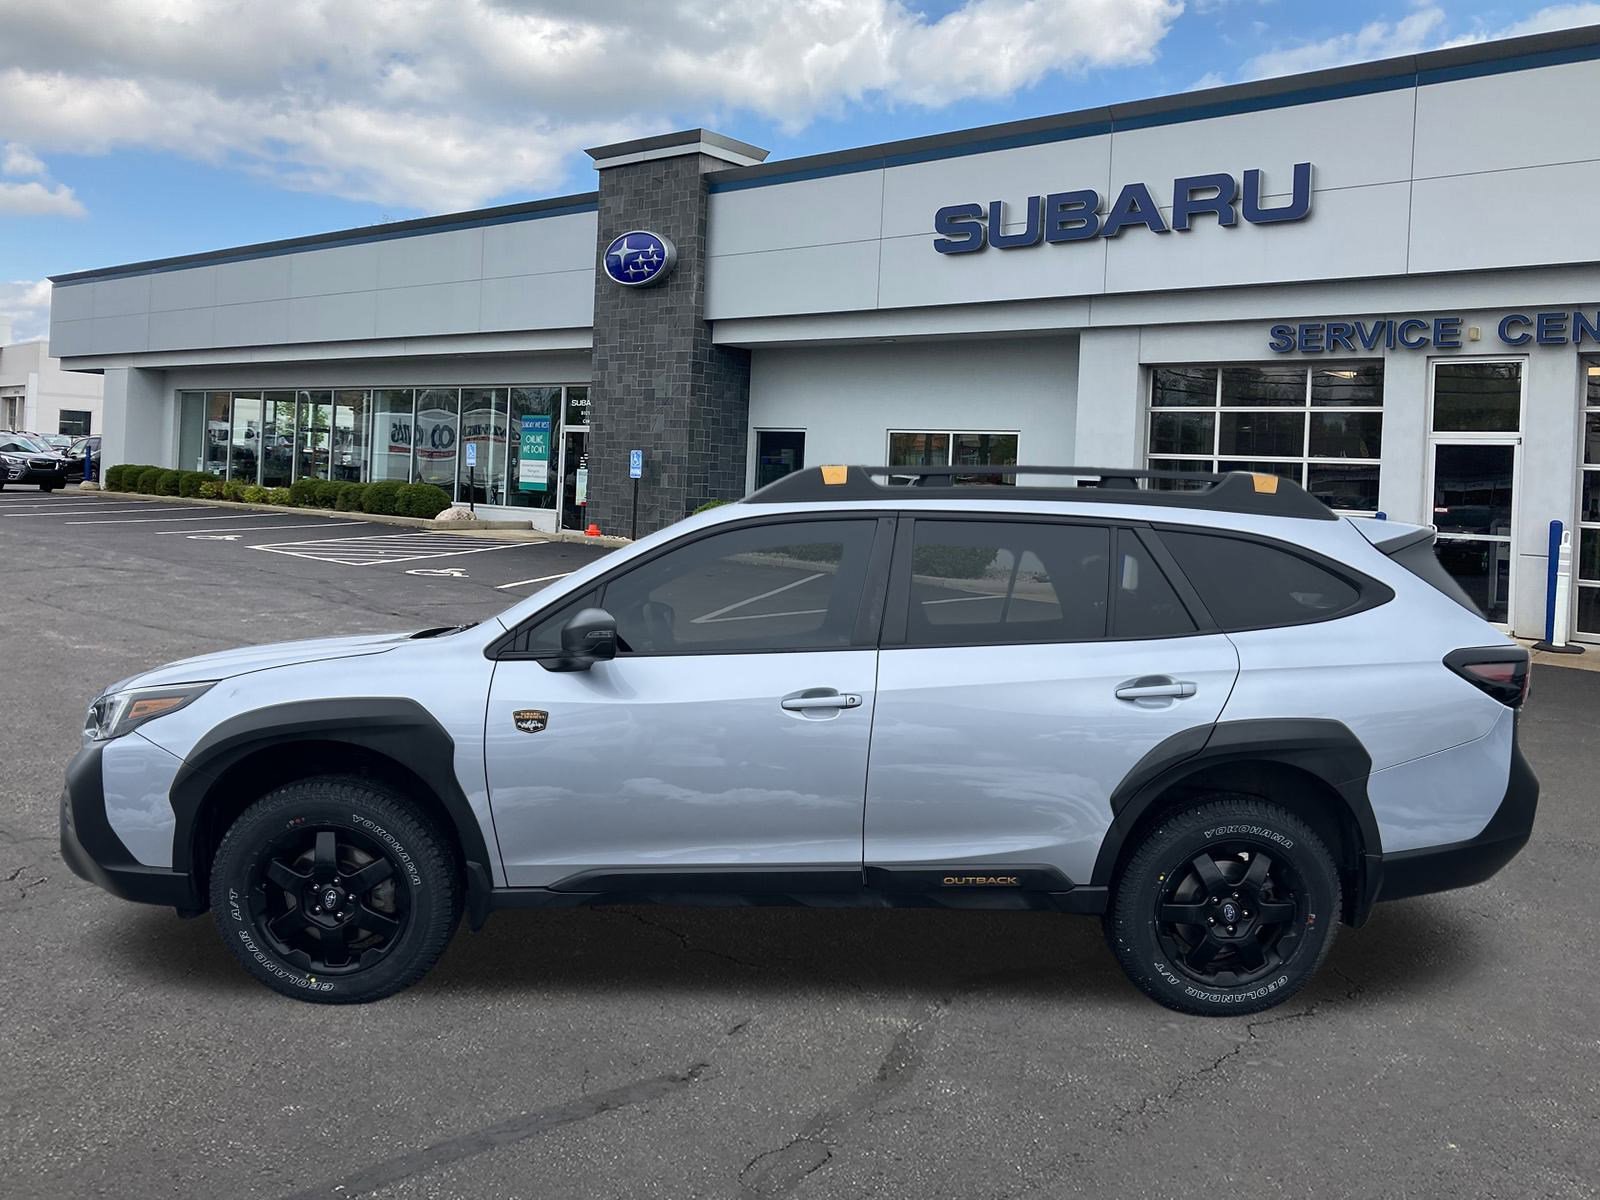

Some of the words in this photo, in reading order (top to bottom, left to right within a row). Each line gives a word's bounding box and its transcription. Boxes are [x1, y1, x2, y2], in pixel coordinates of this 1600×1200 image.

[933, 162, 1313, 255] SUBARU
[1269, 317, 1463, 354] SERVICE
[1498, 312, 1600, 345] CEN
[352, 814, 421, 886] YOKOHAMA
[1203, 824, 1294, 849] YOKOHAMA
[943, 876, 1017, 885] OUTBACK
[228, 887, 242, 922] A/T
[238, 930, 335, 992] GEOLANDAR
[1154, 961, 1181, 985] A/T
[1185, 974, 1288, 1004] GEOLANDAR
